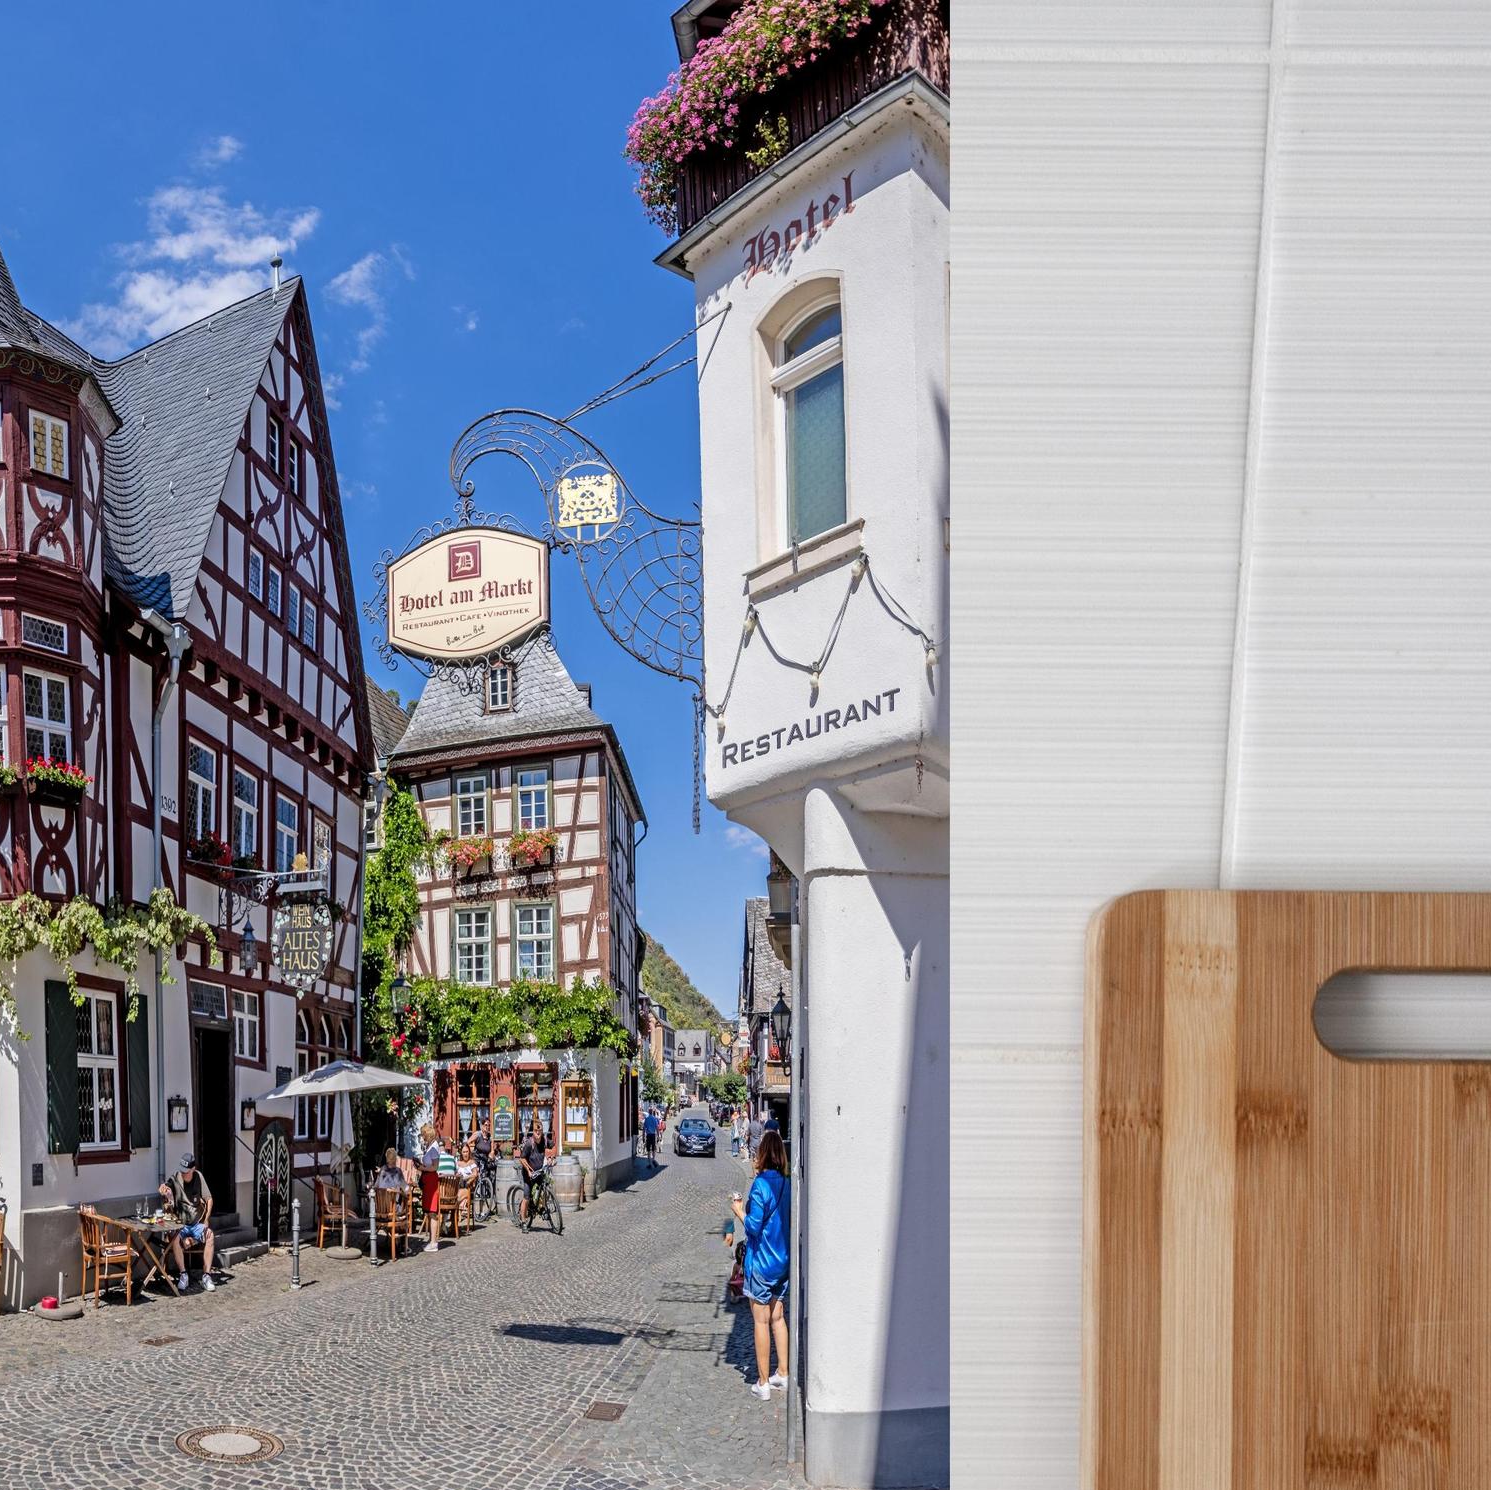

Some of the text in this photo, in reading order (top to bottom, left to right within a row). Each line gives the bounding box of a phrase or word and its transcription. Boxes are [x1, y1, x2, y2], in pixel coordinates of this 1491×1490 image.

[742, 169, 856, 289] Hotel
[399, 579, 533, 616] Hotel am Markt
[402, 618, 454, 631] RESTAURANT
[486, 607, 530, 619] VINOTHEK
[722, 688, 901, 768] RESTAURANT
[292, 904, 310, 916] WEIN
[291, 916, 312, 928] HAUS
[282, 931, 320, 950] ALTES
[282, 951, 319, 970] HAUS
